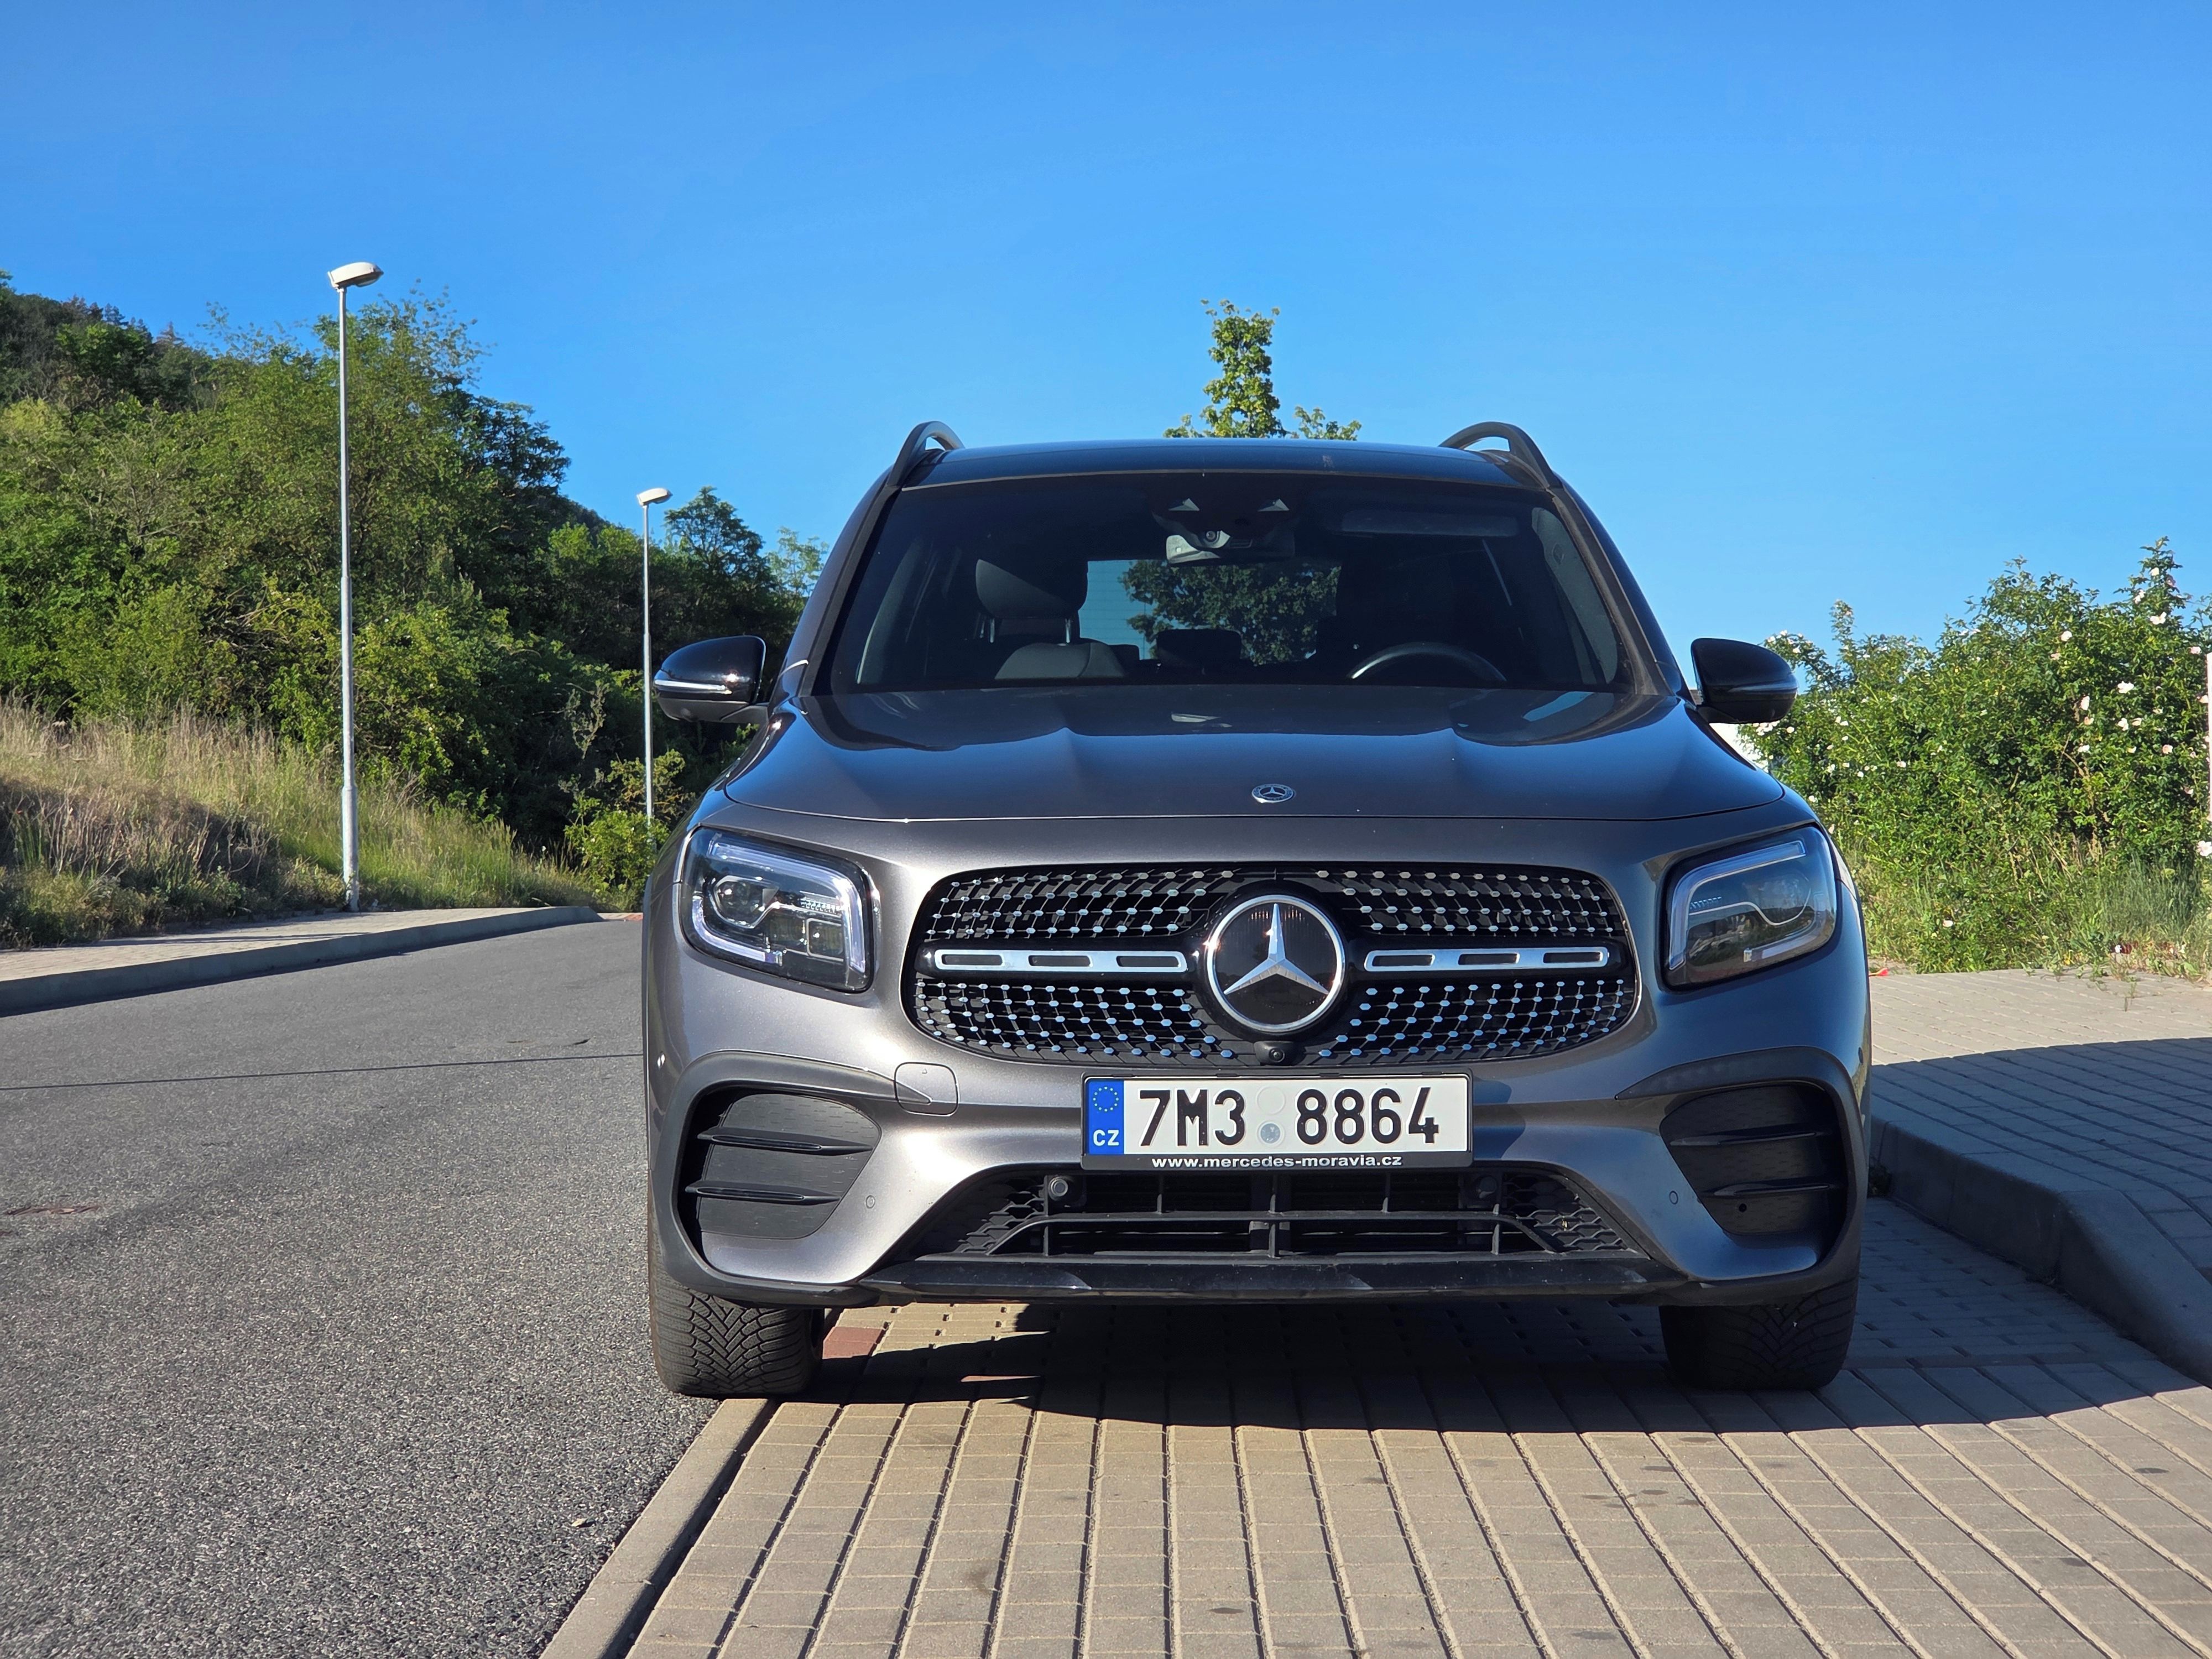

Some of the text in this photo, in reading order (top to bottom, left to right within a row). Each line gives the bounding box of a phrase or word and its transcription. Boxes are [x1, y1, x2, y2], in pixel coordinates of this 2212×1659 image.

[1139, 1087, 1439, 1147] 7M3 8864
[1093, 1129, 1120, 1147] CZ
[1151, 1155, 1402, 1168] www.mercedes-moravia.cz
